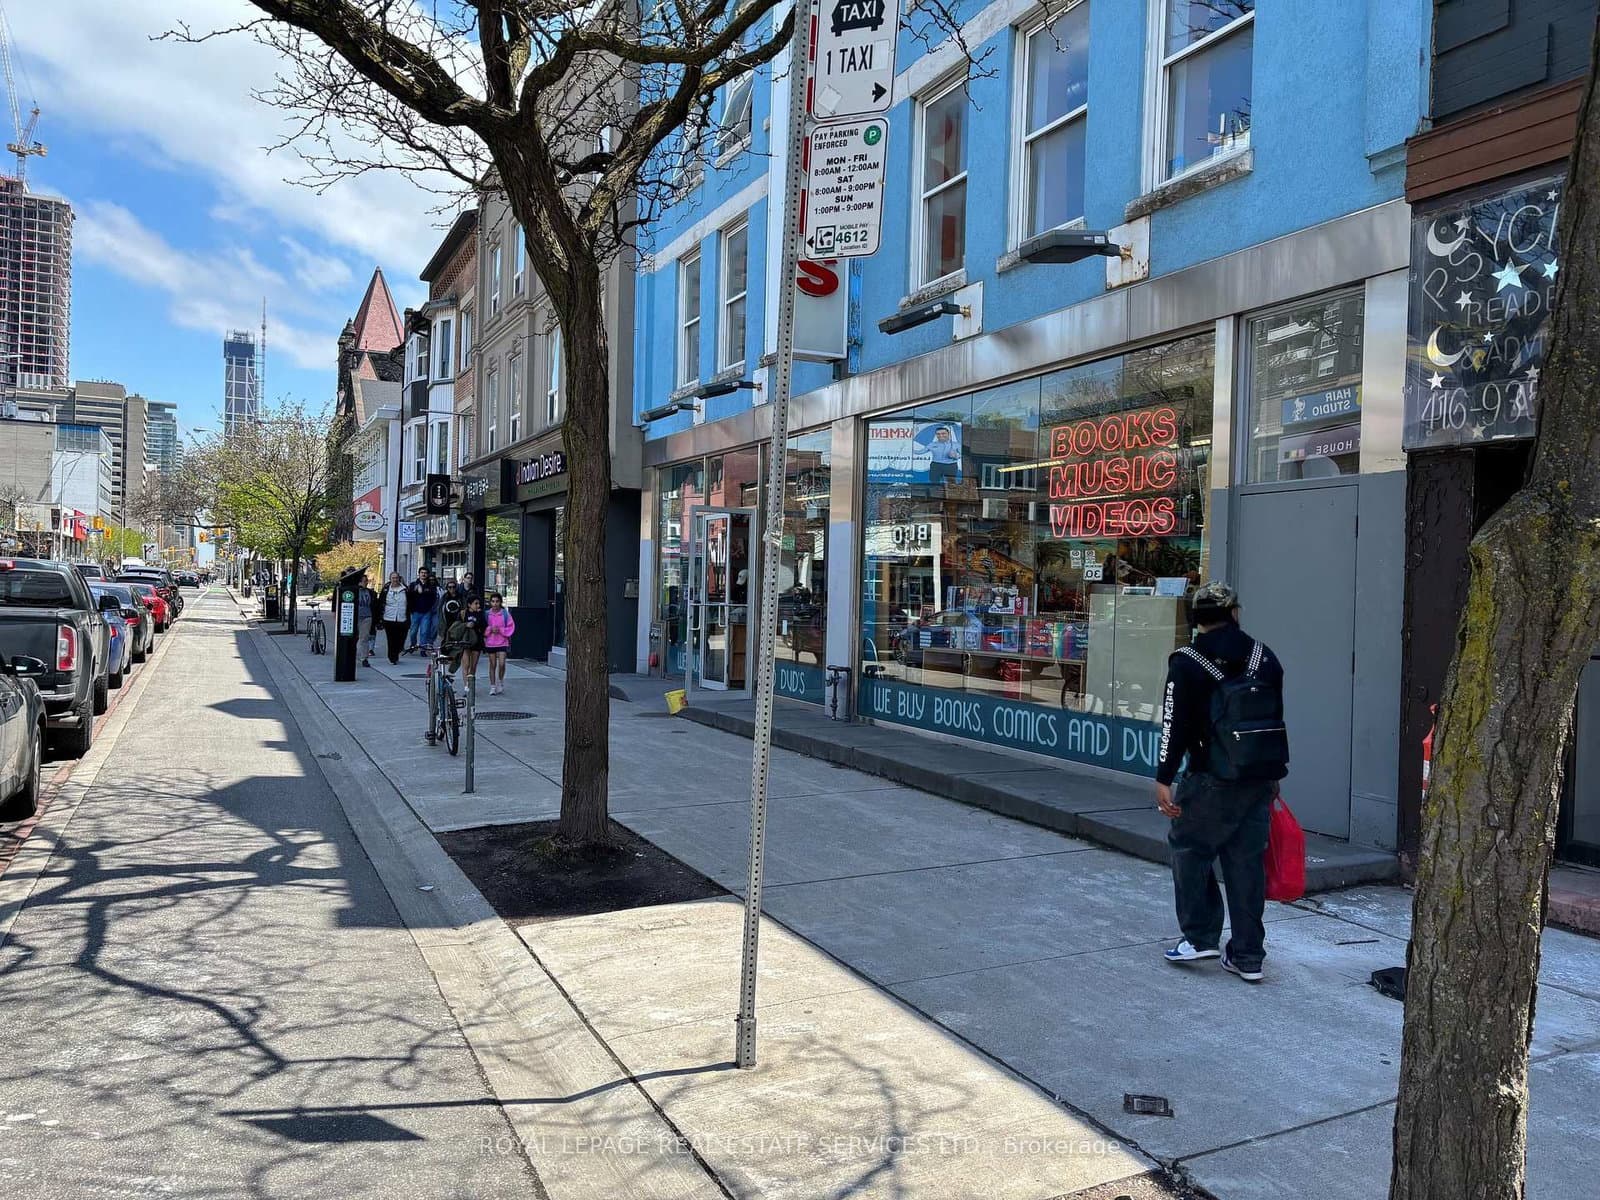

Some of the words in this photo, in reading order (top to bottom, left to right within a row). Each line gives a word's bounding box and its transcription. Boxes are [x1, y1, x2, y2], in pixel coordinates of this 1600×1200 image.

[840, 1, 877, 22] TAXI
[826, 50, 832, 75] 1
[840, 44, 873, 73] TAXI
[814, 132, 828, 141] PAY
[829, 128, 859, 140] PARKING
[814, 139, 848, 150] ENFORCED
[826, 156, 846, 166] MON
[853, 153, 868, 163] FRI
[814, 165, 841, 177] 8:00AM
[848, 162, 880, 174] 12:00AM
[837, 175, 854, 184] SAT
[814, 184, 842, 196] 8:00AM
[848, 181, 876, 193] 9:00PM
[835, 194, 854, 204] SUN
[814, 204, 841, 215] 1:00PM
[846, 201, 874, 213] 9:00PM
[835, 229, 868, 243] 4612
[1050, 408, 1177, 459] BOOKS
[520, 458, 540, 484] Indian
[540, 451, 562, 478] Desire
[1050, 451, 1177, 499] MUSIC
[1050, 497, 1176, 538] VIDEOS
[780, 668, 806, 695] DUD'S
[873, 685, 892, 715] WE
[898, 692, 926, 721] BUY
[934, 698, 986, 737] BOOKS,
[993, 705, 1058, 748] COMICS
[1068, 718, 1111, 757] AND
